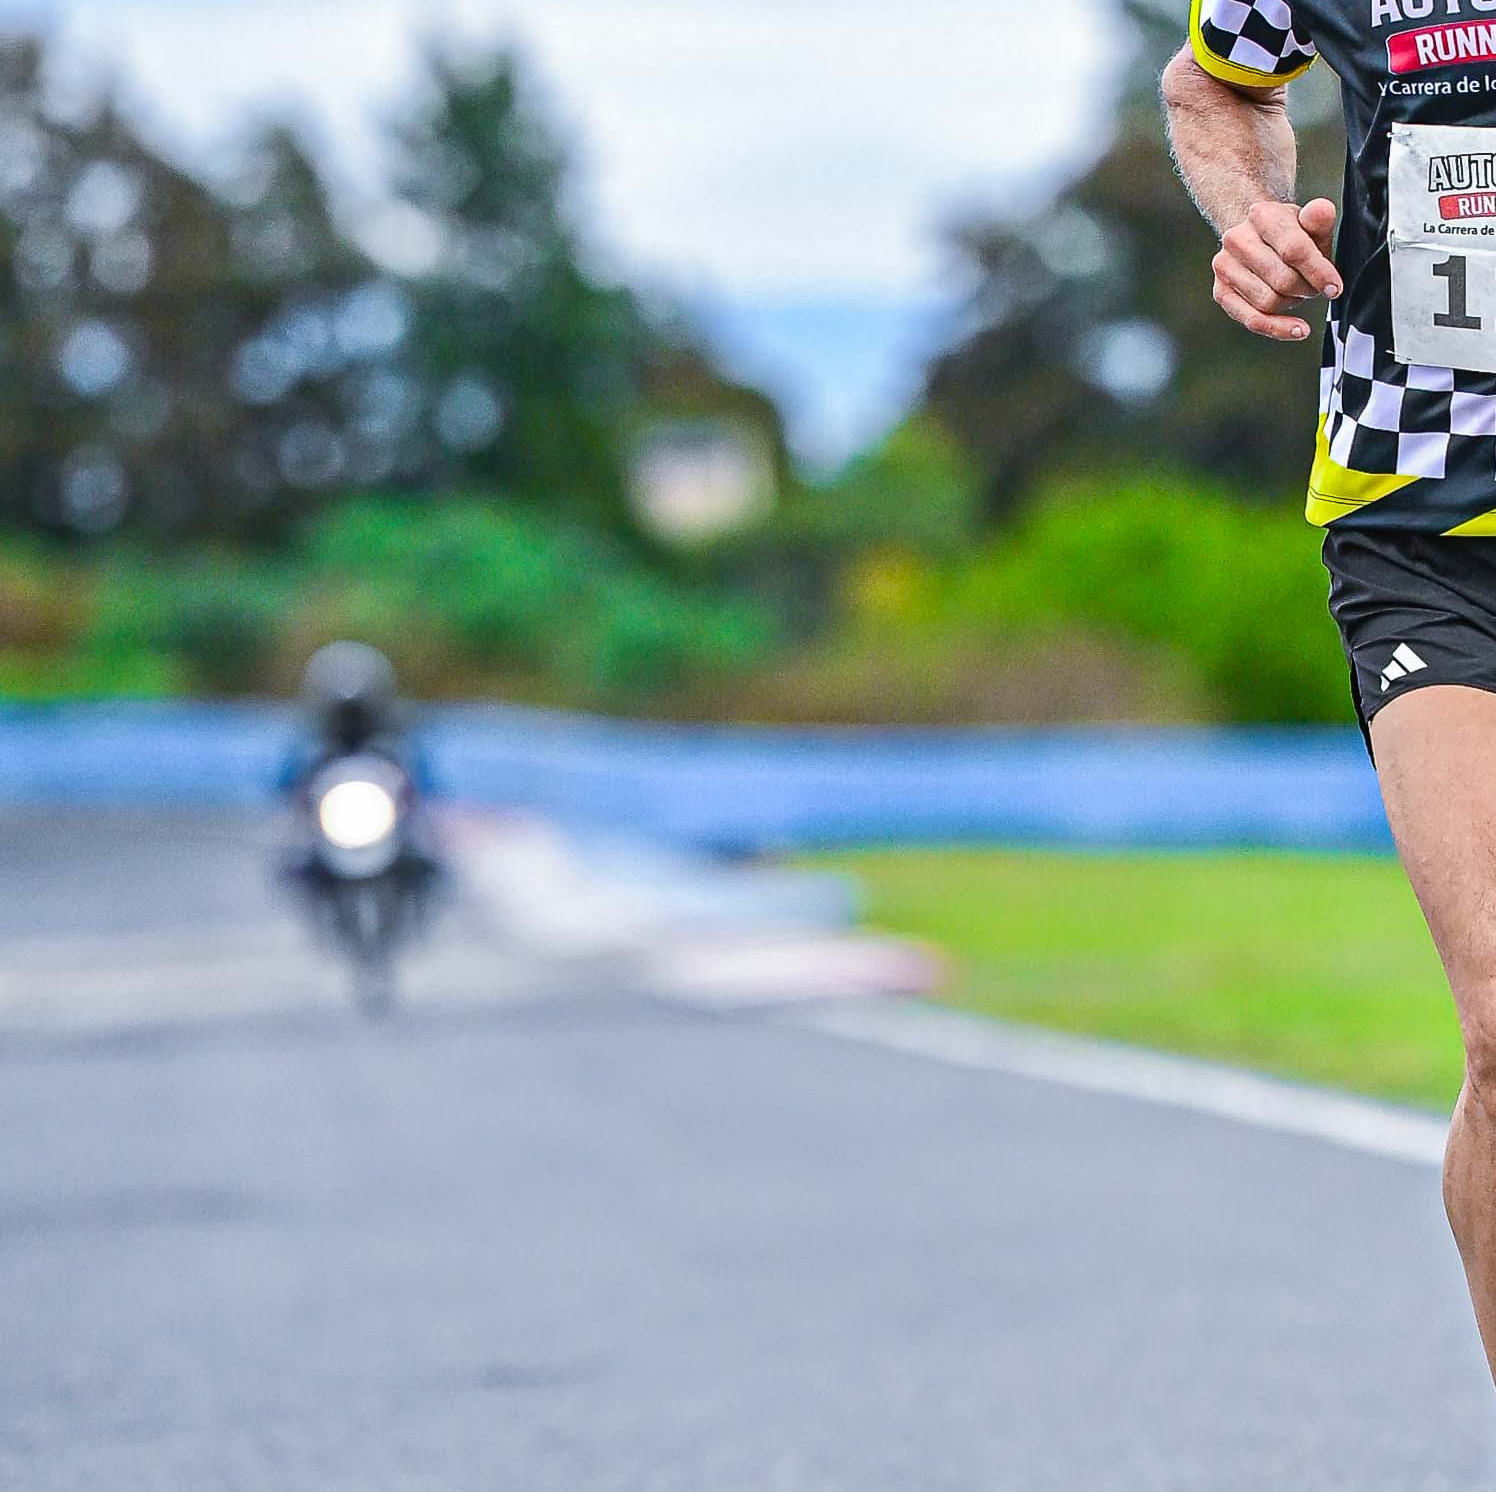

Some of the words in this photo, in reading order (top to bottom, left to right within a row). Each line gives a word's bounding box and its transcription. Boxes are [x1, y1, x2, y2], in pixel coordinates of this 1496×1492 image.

[1456, 75, 1480, 93] de
[1423, 222, 1436, 234] La
[1438, 223, 1478, 235] Carrera
[1480, 224, 1495, 236] de
